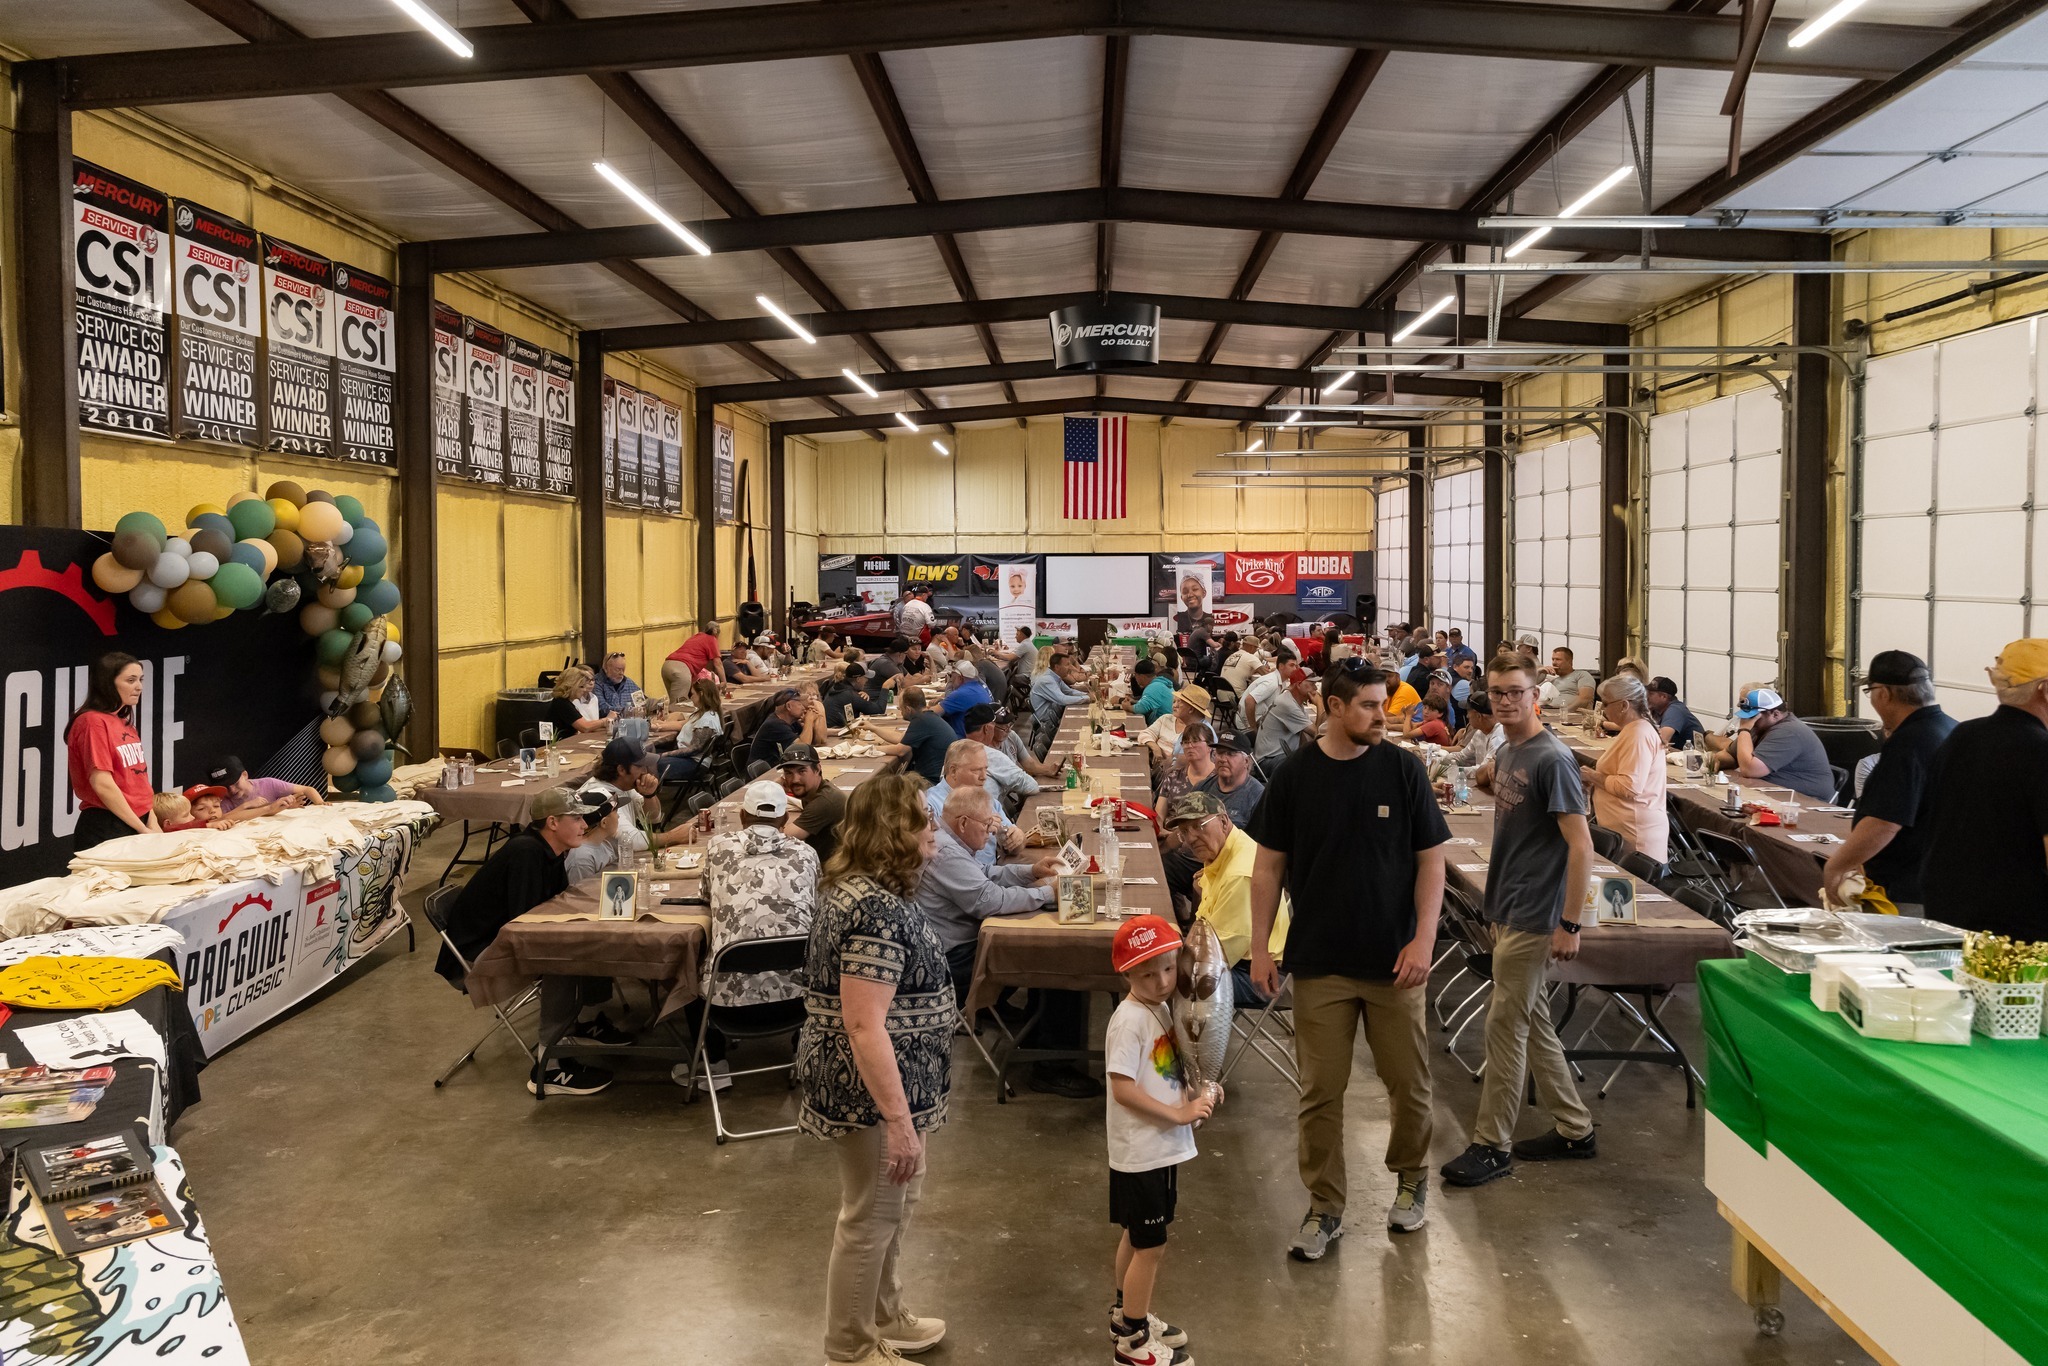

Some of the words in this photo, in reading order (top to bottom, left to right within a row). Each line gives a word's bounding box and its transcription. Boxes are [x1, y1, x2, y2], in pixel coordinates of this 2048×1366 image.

[76, 171, 163, 217] MERCURY
[86, 212, 135, 238] SERVICE
[195, 217, 254, 249] MERCURY
[191, 247, 231, 270] SERVICE
[270, 245, 329, 278] MERCURY
[277, 277, 311, 297] SERVICE
[349, 276, 390, 299] MERCURY
[87, 296, 122, 313] Customers
[123, 305, 140, 319] Have
[346, 302, 375, 318] SERVICE
[76, 311, 139, 348] SERVICE
[141, 329, 164, 354] CSI
[180, 319, 191, 330] Our
[191, 323, 222, 340] Customers
[222, 332, 235, 343] Have
[1074, 323, 1157, 339] MERCURY
[1100, 338, 1116, 346] GO
[80, 338, 161, 382] AWARD
[181, 338, 234, 369] SERVICE
[235, 352, 254, 374] CSI
[516, 345, 540, 361] MERCURY
[269, 359, 313, 386] SERVICE
[313, 370, 330, 390] CSI
[551, 358, 573, 374] MERCURY
[77, 367, 166, 412] WINNER
[186, 361, 252, 398] AWARD
[341, 377, 378, 401] SERVICE
[378, 386, 392, 404] CSI
[182, 388, 256, 426] WINNER
[273, 380, 328, 413] AWARD
[87, 406, 155, 432] 2010
[271, 404, 332, 438] WINNER
[345, 396, 390, 425] AWARD
[198, 422, 244, 445] 2011
[279, 436, 326, 454] 2012
[342, 418, 394, 448] WINNER
[349, 447, 387, 463] 2013
[437, 460, 457, 474] 014
[510, 455, 541, 477] WINNER
[620, 472, 637, 484] 2019
[863, 560, 891, 571] PRO-GUIDE
[1235, 558, 1264, 582] Strike
[1264, 557, 1285, 582] King
[1297, 556, 1351, 575] BUBBA
[1131, 622, 1162, 630] YAMAHA
[1212, 612, 1242, 620] TCH
[313, 886, 334, 899] Benefiting
[1127, 928, 1158, 949] PRO-GUIDE
[183, 909, 293, 1008] PRO-GUIDE
[226, 967, 286, 1017] CLASSIC
[194, 1003, 223, 1038] OPE
